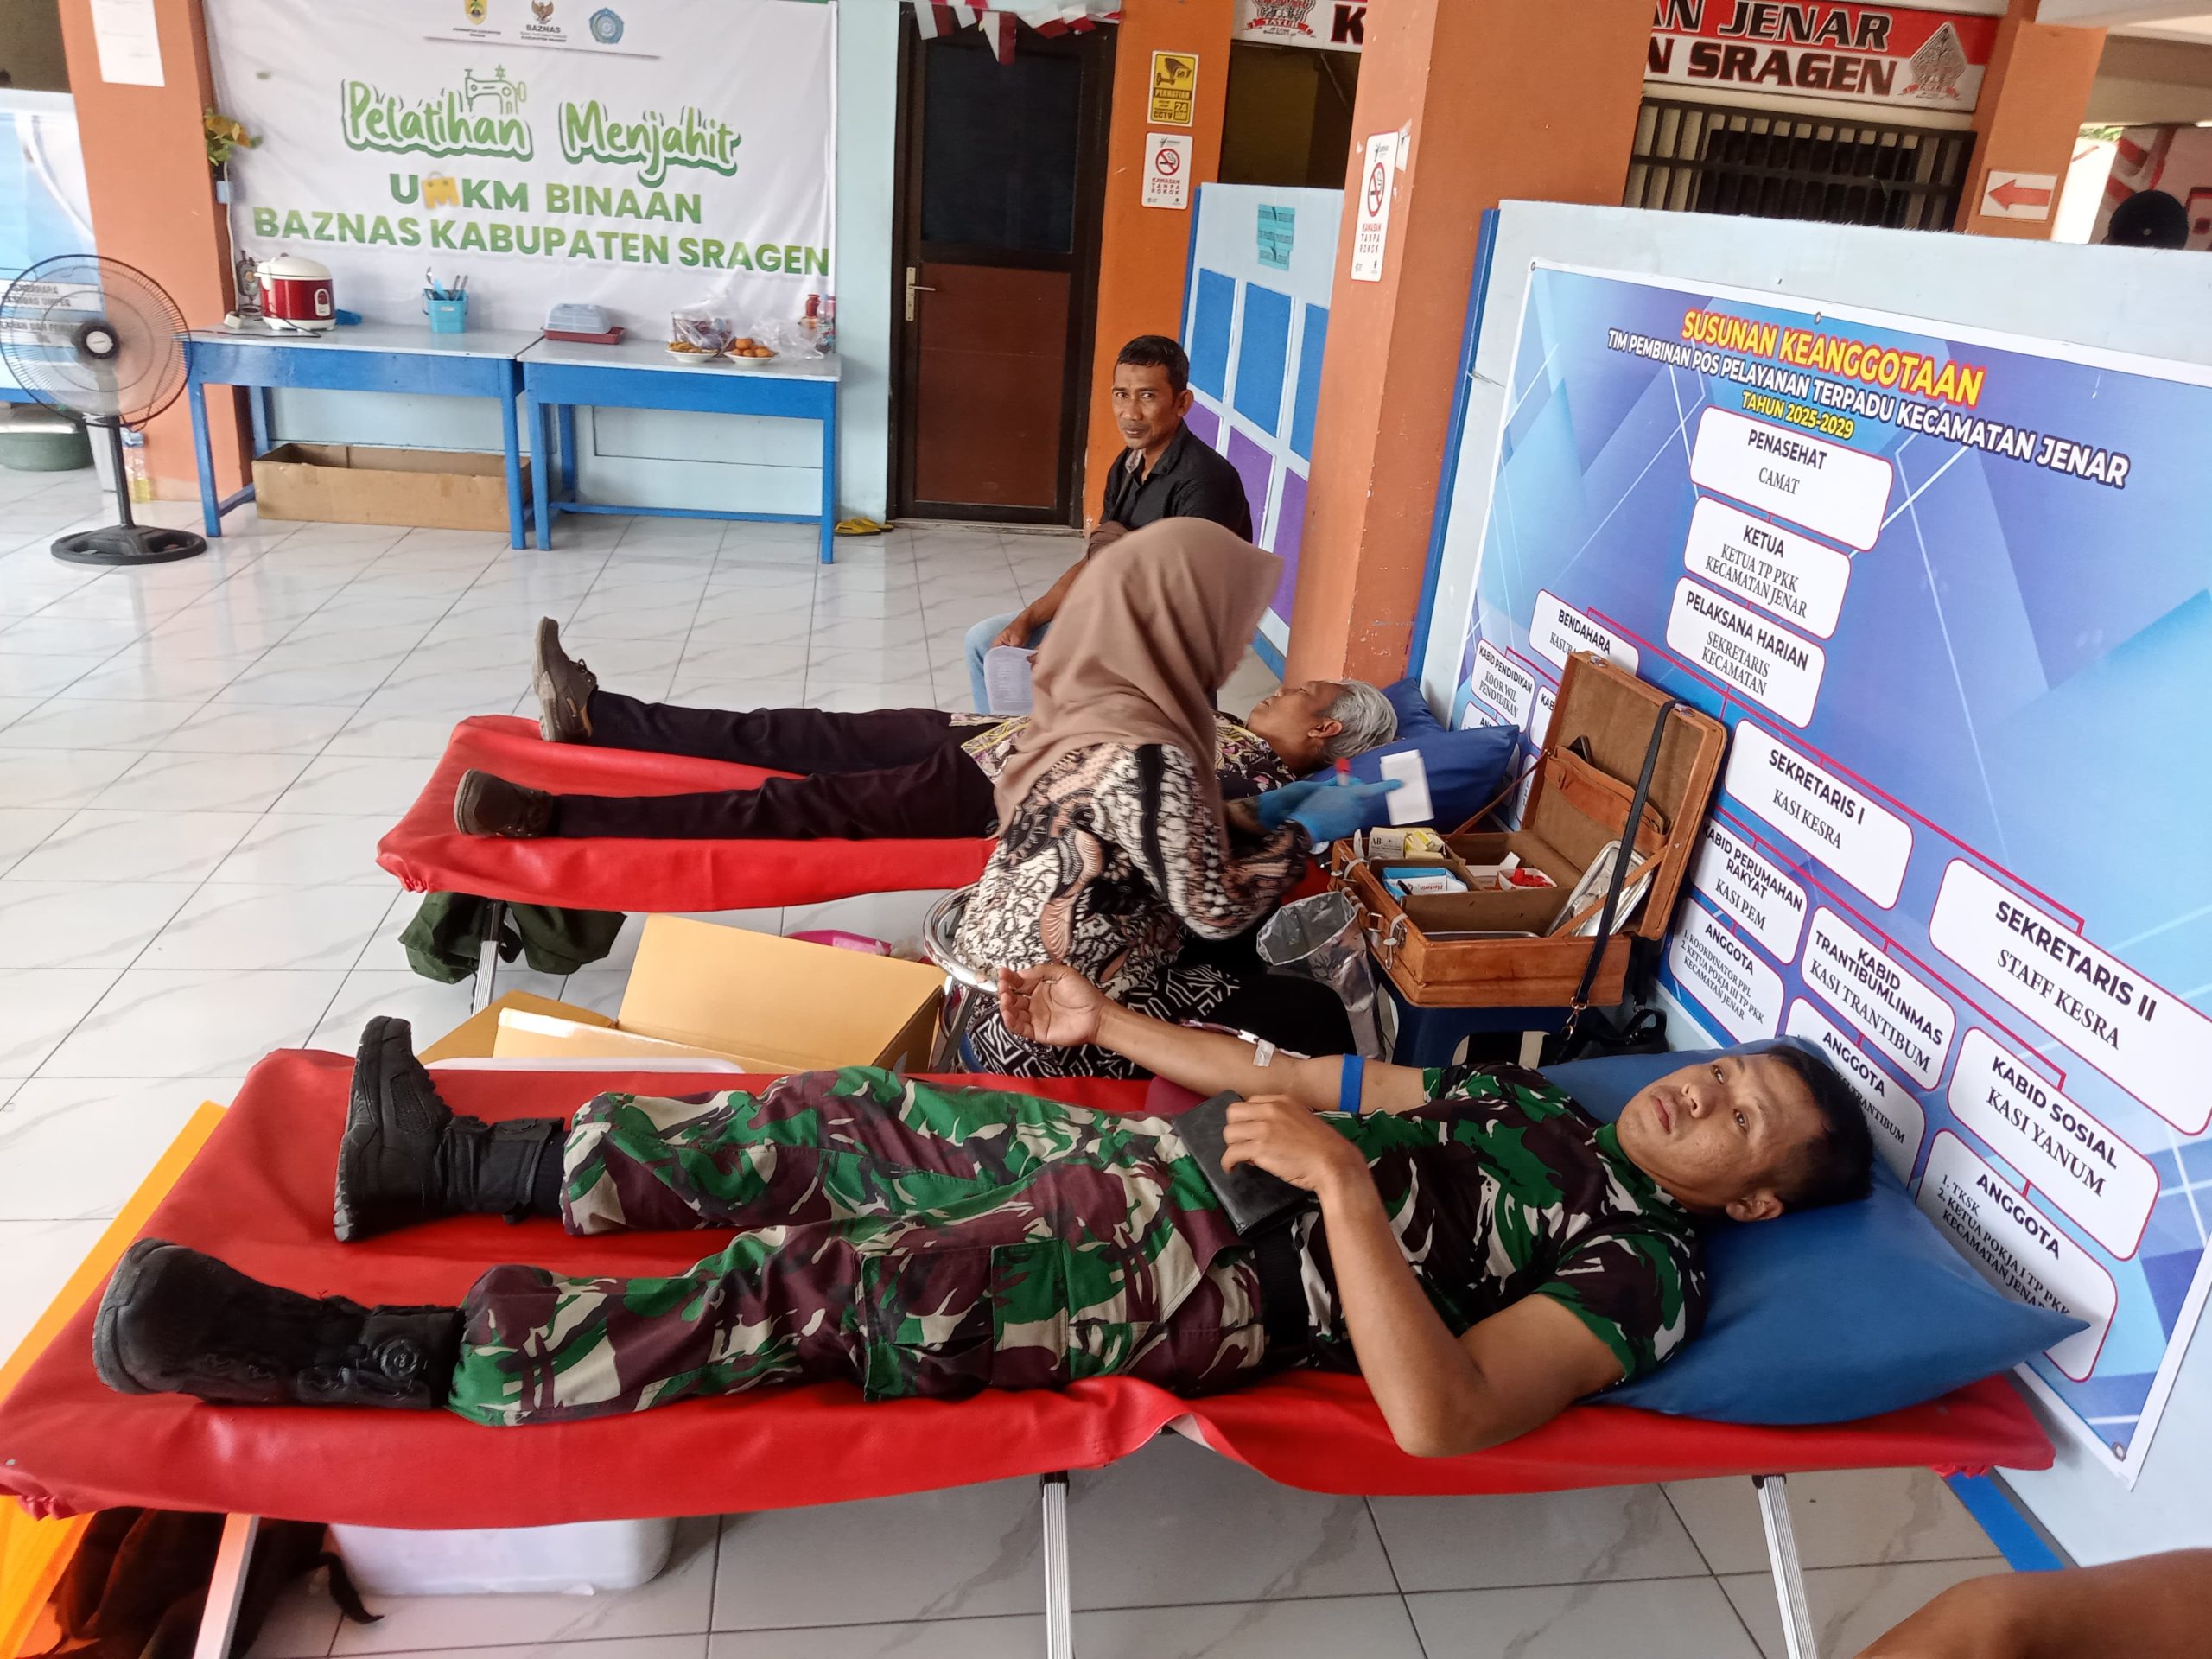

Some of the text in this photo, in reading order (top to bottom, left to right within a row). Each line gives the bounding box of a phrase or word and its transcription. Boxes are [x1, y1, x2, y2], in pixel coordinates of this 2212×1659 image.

[1718, 0, 1891, 51] JENAR
[1688, 41, 1897, 96] SRAGEN
[344, 79, 737, 181] Pelatihan Menjahit
[546, 183, 701, 224] BINAAN
[254, 207, 829, 276] BAZNAS KABUPATEN SRAGEN
[1681, 310, 1986, 405] SUSUNAN KEANGGOTAAN
[1607, 329, 2132, 488] TIM PEMBINAN POS PELAYANAN TERPADU KECAMATAN JENAR
[1742, 390, 1855, 440] TAHUN 2025-2029
[1747, 429, 1827, 470] PENASEHAT
[1758, 467, 1800, 495] CAMAT
[1721, 543, 1799, 593] KETUA TP PKK
[1743, 524, 1784, 558] KETUA
[1705, 556, 1808, 619] KECAMATAN JENAR
[1550, 632, 1576, 654] KASUB
[1558, 609, 1611, 655] BENDAHARA
[1686, 590, 1808, 671] PELAKSANA HARIAN
[1707, 630, 1770, 678] SEKRETARIS
[1479, 645, 1532, 694] KABID PENDIDIKAN
[1479, 680, 1518, 718] PENDIDIKAN
[1485, 671, 1516, 702] KOOR WIL
[1701, 647, 1768, 696] KECAMATAN
[1541, 694, 1555, 710] KAB
[1769, 749, 1865, 825] SEKRETARIS I
[1773, 788, 1840, 850] KASI KESRA
[1715, 878, 1766, 931] KASI PEM
[1726, 858, 1767, 899] RAKYAT
[1733, 848, 1802, 912] PERUMAHAN
[1684, 929, 1751, 998] 1. KOORDINATOR PPL
[1705, 923, 1754, 976] ANGGOTA
[1858, 948, 1901, 990] KABID
[1995, 900, 2157, 1022] SEKRETARIS II
[1681, 940, 1764, 1025] 2. KETUA POKJA III TP PKK
[1683, 955, 1745, 1020] KECAMATAN JENAR
[1815, 930, 1943, 1046] TRANTIBUMLINMAS
[1997, 949, 2120, 1051] STAFF KESRA
[1809, 959, 1931, 1073] KASI TRANTIBUM
[1822, 1031, 1885, 1097] ANGGOTA
[1986, 1086, 2106, 1198] KASI YANUM
[1992, 1055, 2117, 1170] KABID SOSIAL
[1942, 1174, 1980, 1217] 1. TKSK
[1976, 1173, 2059, 1260] ANGGOTA
[1937, 1187, 1945, 1202] 2.
[1947, 1196, 1982, 1237] KETUA
[1982, 1230, 2019, 1274] POKJA
[2018, 1267, 2026, 1279] I
[2027, 1271, 2044, 1293] TP
[1942, 1210, 2009, 1281] KECAMATAN
